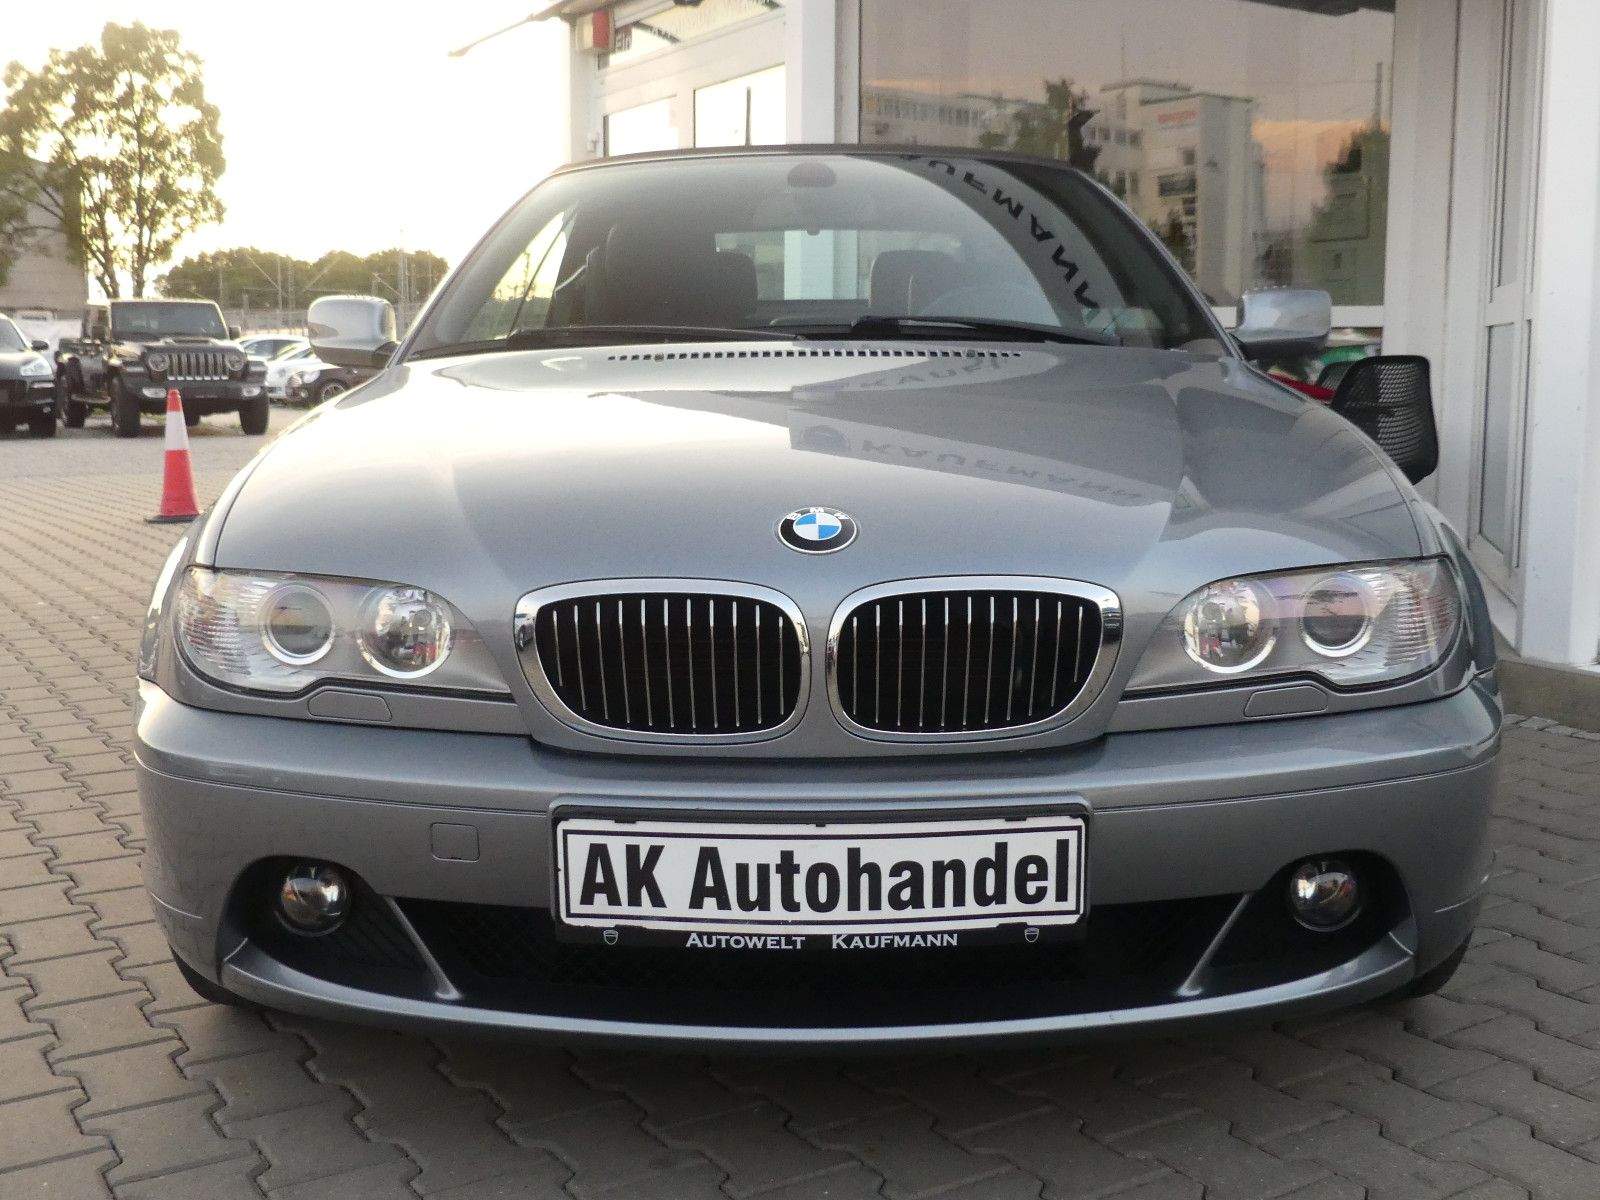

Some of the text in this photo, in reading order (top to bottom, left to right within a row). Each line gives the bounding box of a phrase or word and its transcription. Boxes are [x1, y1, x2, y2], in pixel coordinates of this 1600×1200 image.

[579, 838, 1070, 912] AK Autohandel
[686, 932, 958, 949] AUTOWELT KAUFMANN
